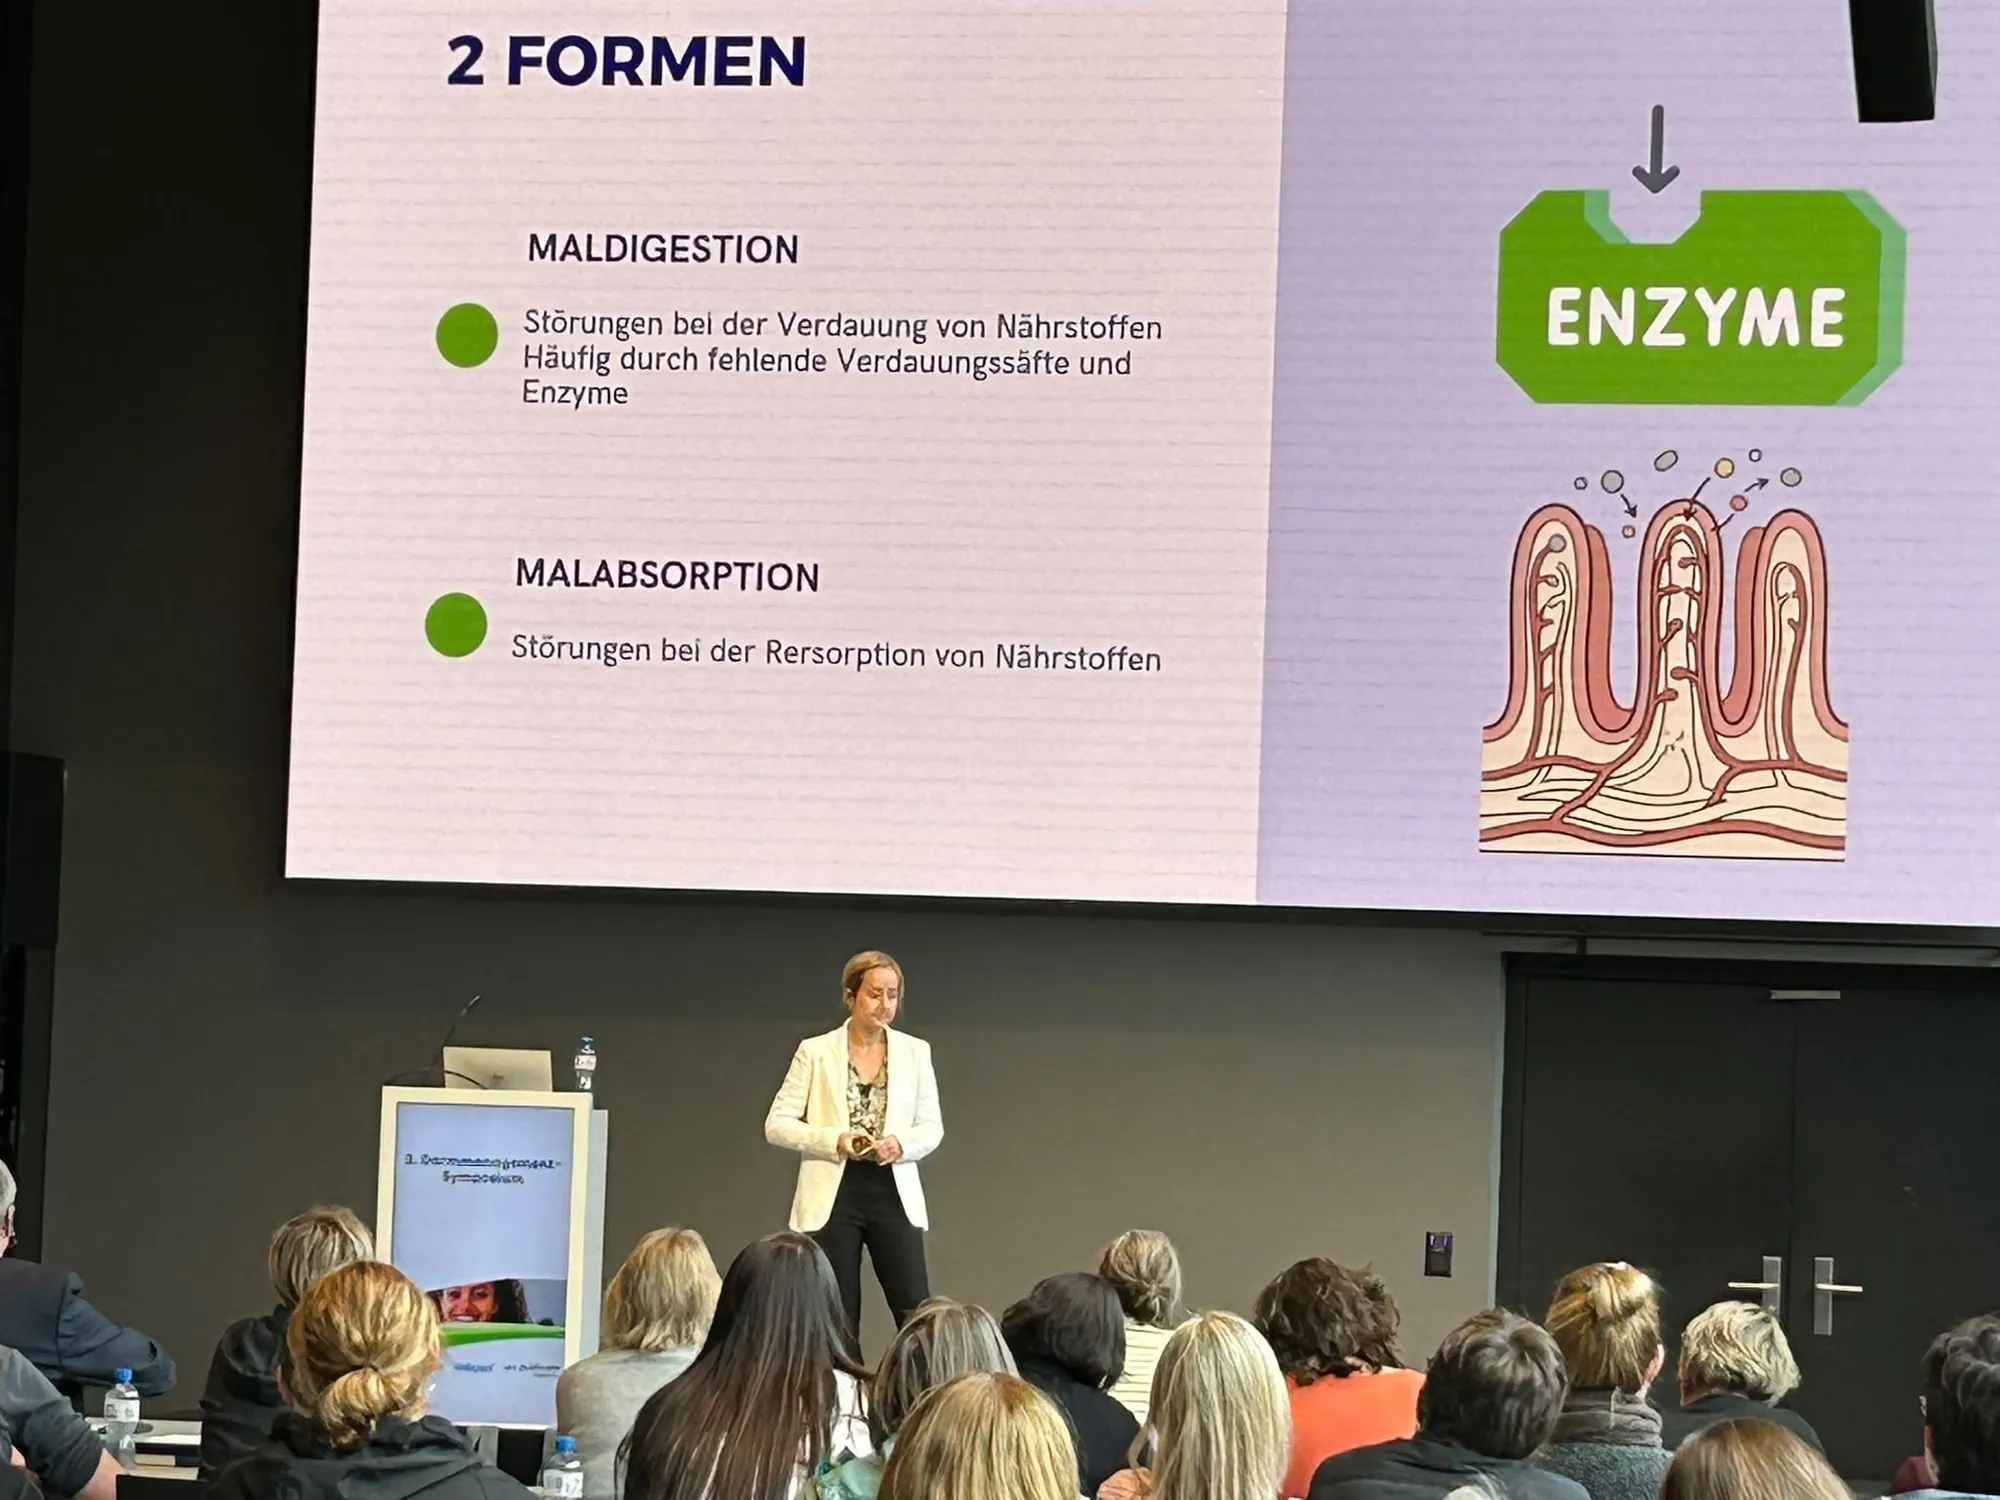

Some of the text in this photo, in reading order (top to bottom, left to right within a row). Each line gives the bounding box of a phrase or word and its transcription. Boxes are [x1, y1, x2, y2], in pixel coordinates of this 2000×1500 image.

[447, 34, 806, 87] 2 FORMEN
[528, 232, 799, 264] MALDIGESTION
[523, 309, 1162, 345] Störungen bei der Verdauung von Nährstoffen
[1547, 286, 1846, 348] ENZYME
[523, 343, 1132, 382] Häufig durch fehlende Verdauungssäfte und
[522, 378, 629, 411] Enzyme
[516, 557, 819, 593] MALABSORPTION
[511, 633, 1161, 673] Störungen bei der Rersorption von Nährstoffen
